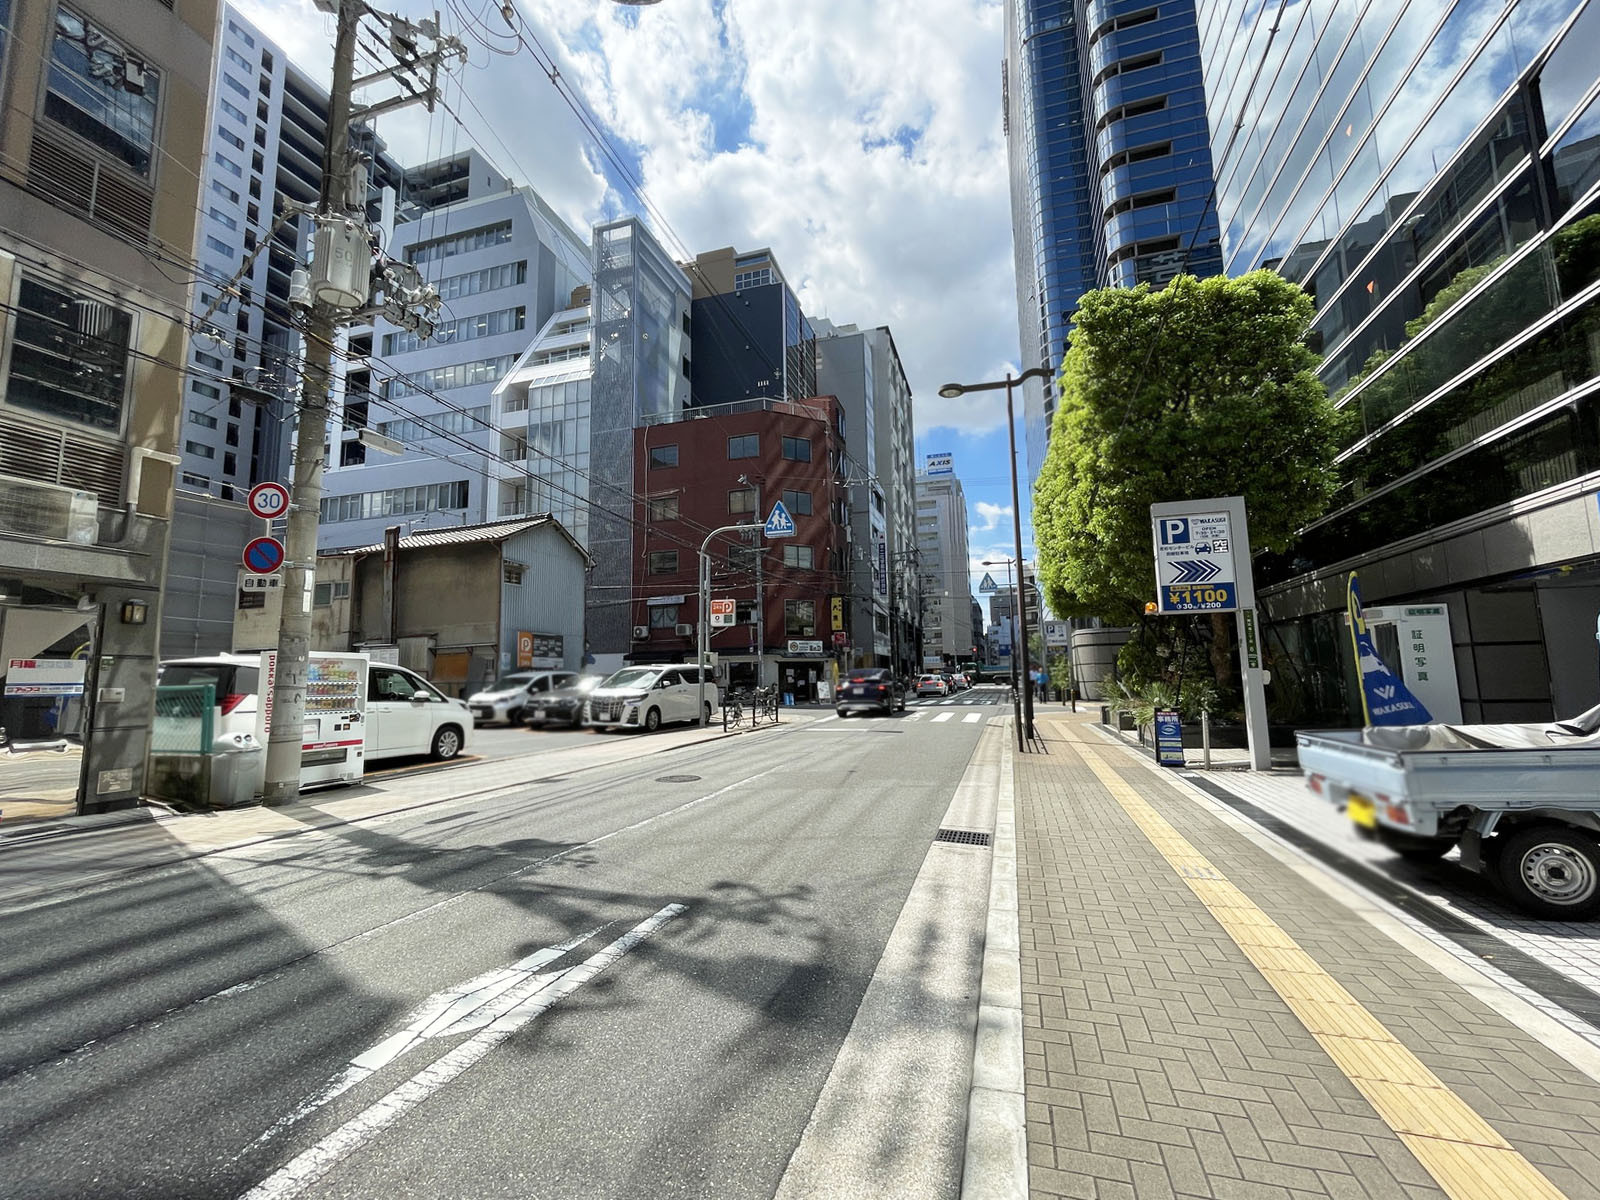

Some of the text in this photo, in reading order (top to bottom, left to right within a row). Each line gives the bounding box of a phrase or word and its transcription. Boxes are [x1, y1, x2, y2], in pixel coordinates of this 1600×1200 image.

[929, 459, 951, 467] AXIS
[257, 492, 280, 509] 30
[1165, 519, 1185, 544] P
[1213, 539, 1228, 553] 空
[244, 578, 279, 588] 自動車
[1169, 589, 1228, 604] ¥1100
[1410, 629, 1430, 682] 証明写真
